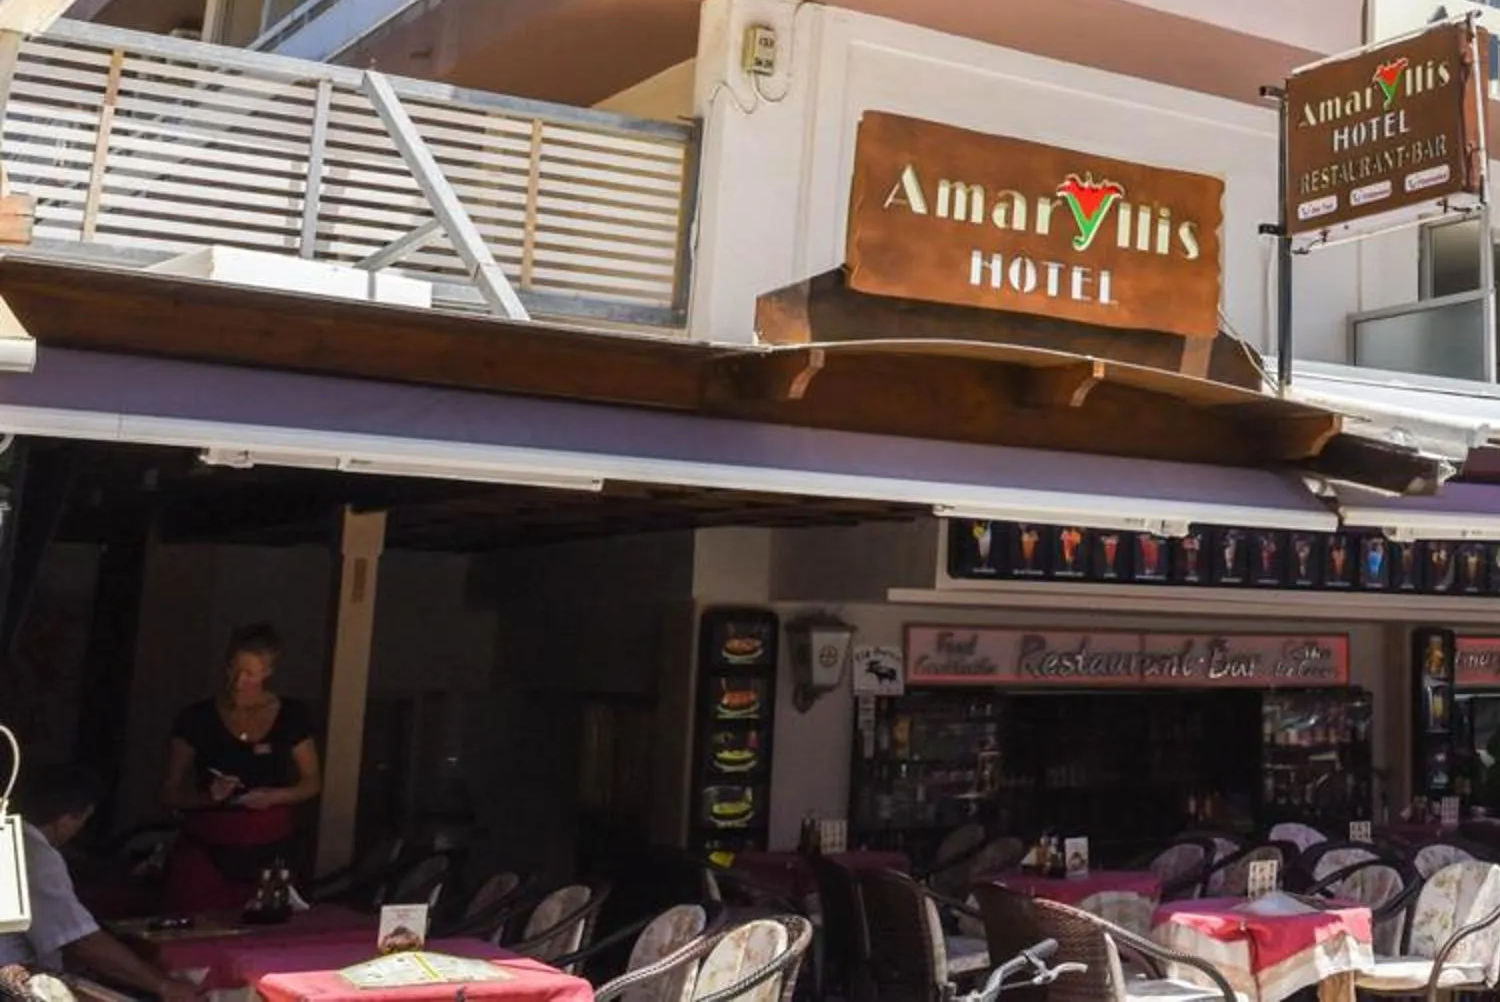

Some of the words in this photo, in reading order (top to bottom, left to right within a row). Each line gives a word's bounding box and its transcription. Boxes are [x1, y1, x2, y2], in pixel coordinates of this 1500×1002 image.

[1300, 57, 1450, 128] Amaryllis
[1333, 109, 1411, 153] HOTEL
[884, 163, 1199, 260] Amaryllis
[969, 250, 1117, 305] HOTEL
